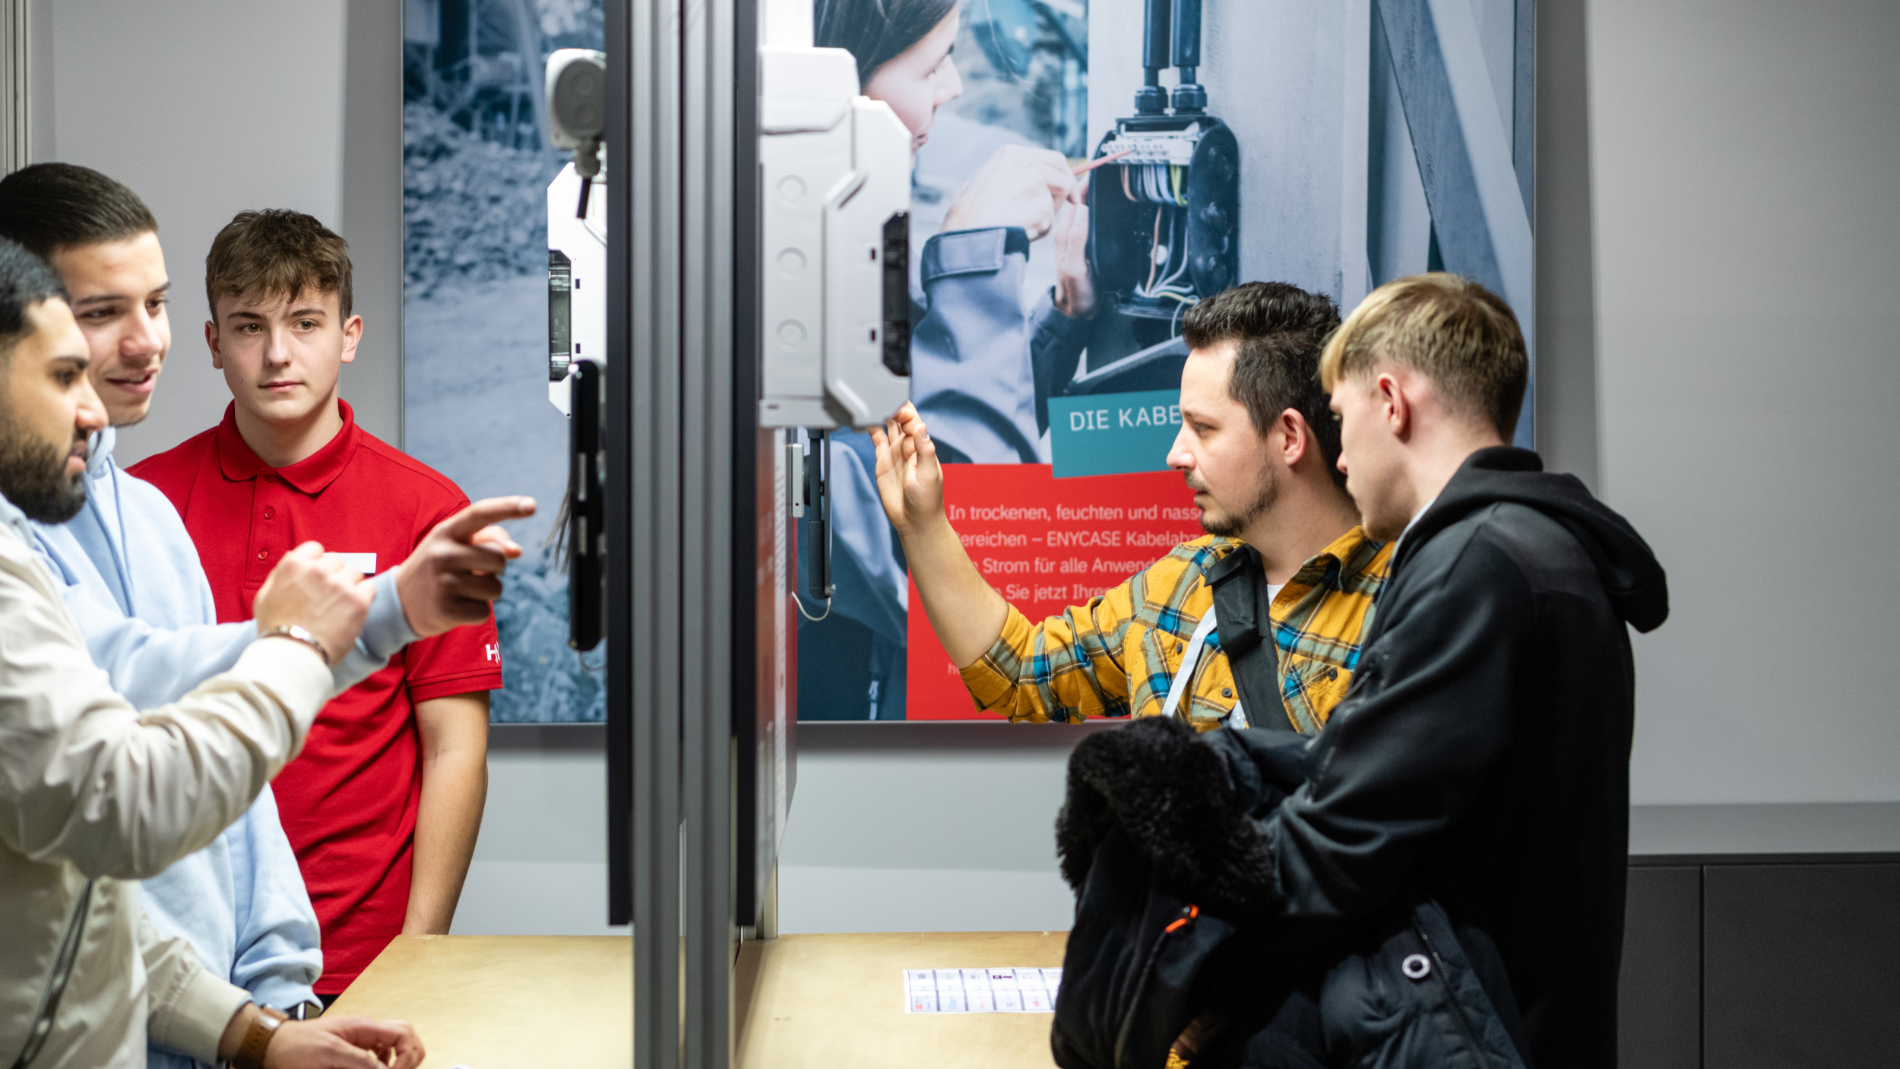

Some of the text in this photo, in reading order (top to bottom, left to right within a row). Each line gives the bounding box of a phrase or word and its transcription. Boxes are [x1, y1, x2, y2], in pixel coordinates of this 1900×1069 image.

[1070, 405, 1182, 431] DIE KABE
[949, 504, 966, 520] In
[970, 504, 1051, 522] trockenen,
[1056, 504, 1123, 520] feuchten
[1128, 504, 1158, 520] und
[955, 531, 1027, 547] ereichen
[1047, 531, 1121, 547] ENYCASE
[983, 557, 1030, 573] Strom
[1034, 557, 1056, 573] für
[1060, 557, 1088, 573] alle
[1006, 584, 1030, 600] Sie
[1033, 584, 1067, 603] jetzt
[1073, 584, 1112, 599] Ihre
